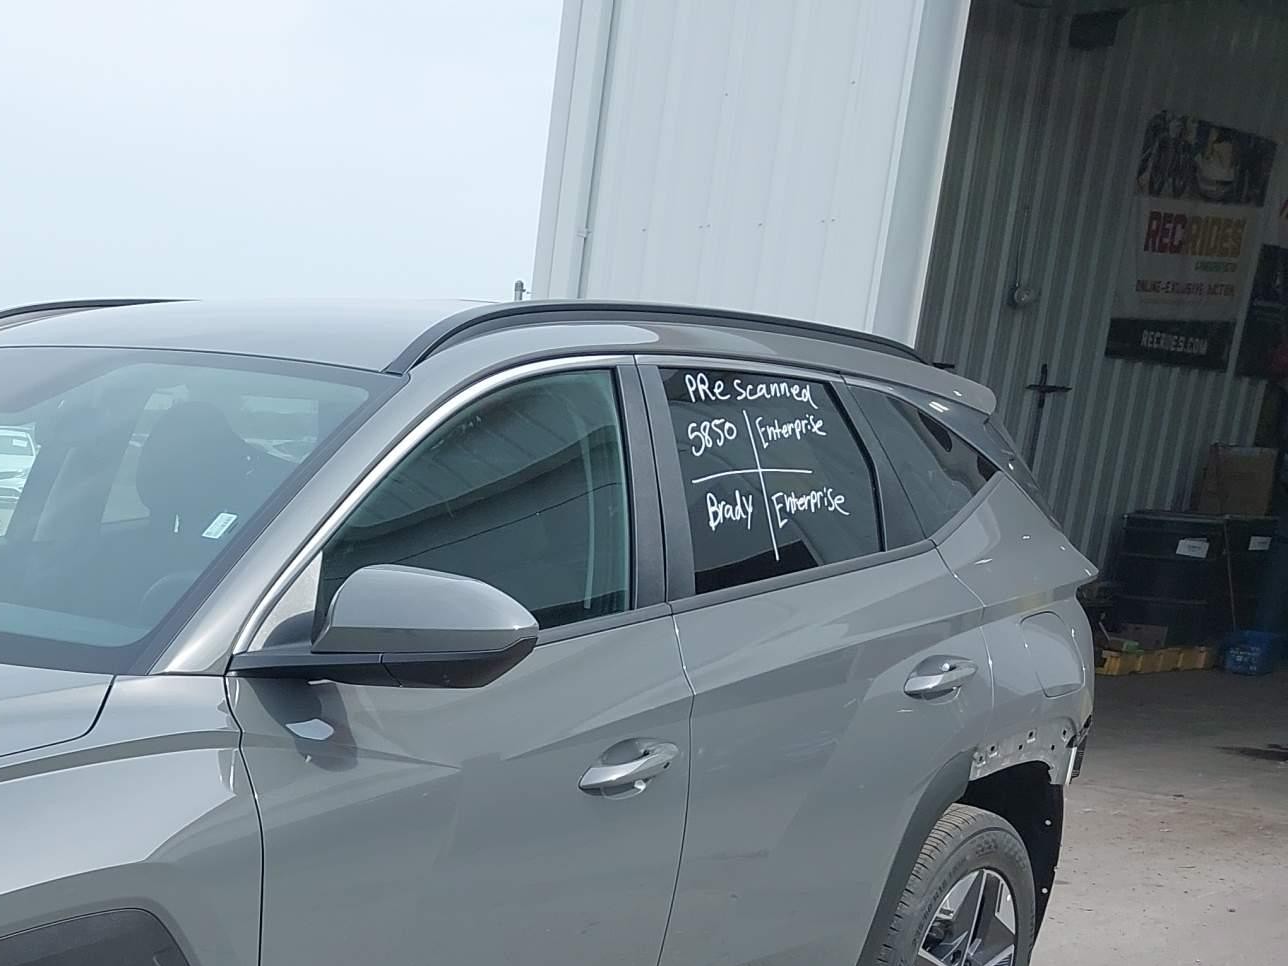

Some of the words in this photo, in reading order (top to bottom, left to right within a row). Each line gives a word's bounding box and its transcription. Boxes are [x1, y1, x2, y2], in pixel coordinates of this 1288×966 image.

[688, 418, 737, 456] 5850
[755, 414, 827, 448] Enterprise
[706, 490, 753, 531] Brady
[771, 487, 851, 528] Enterprise
